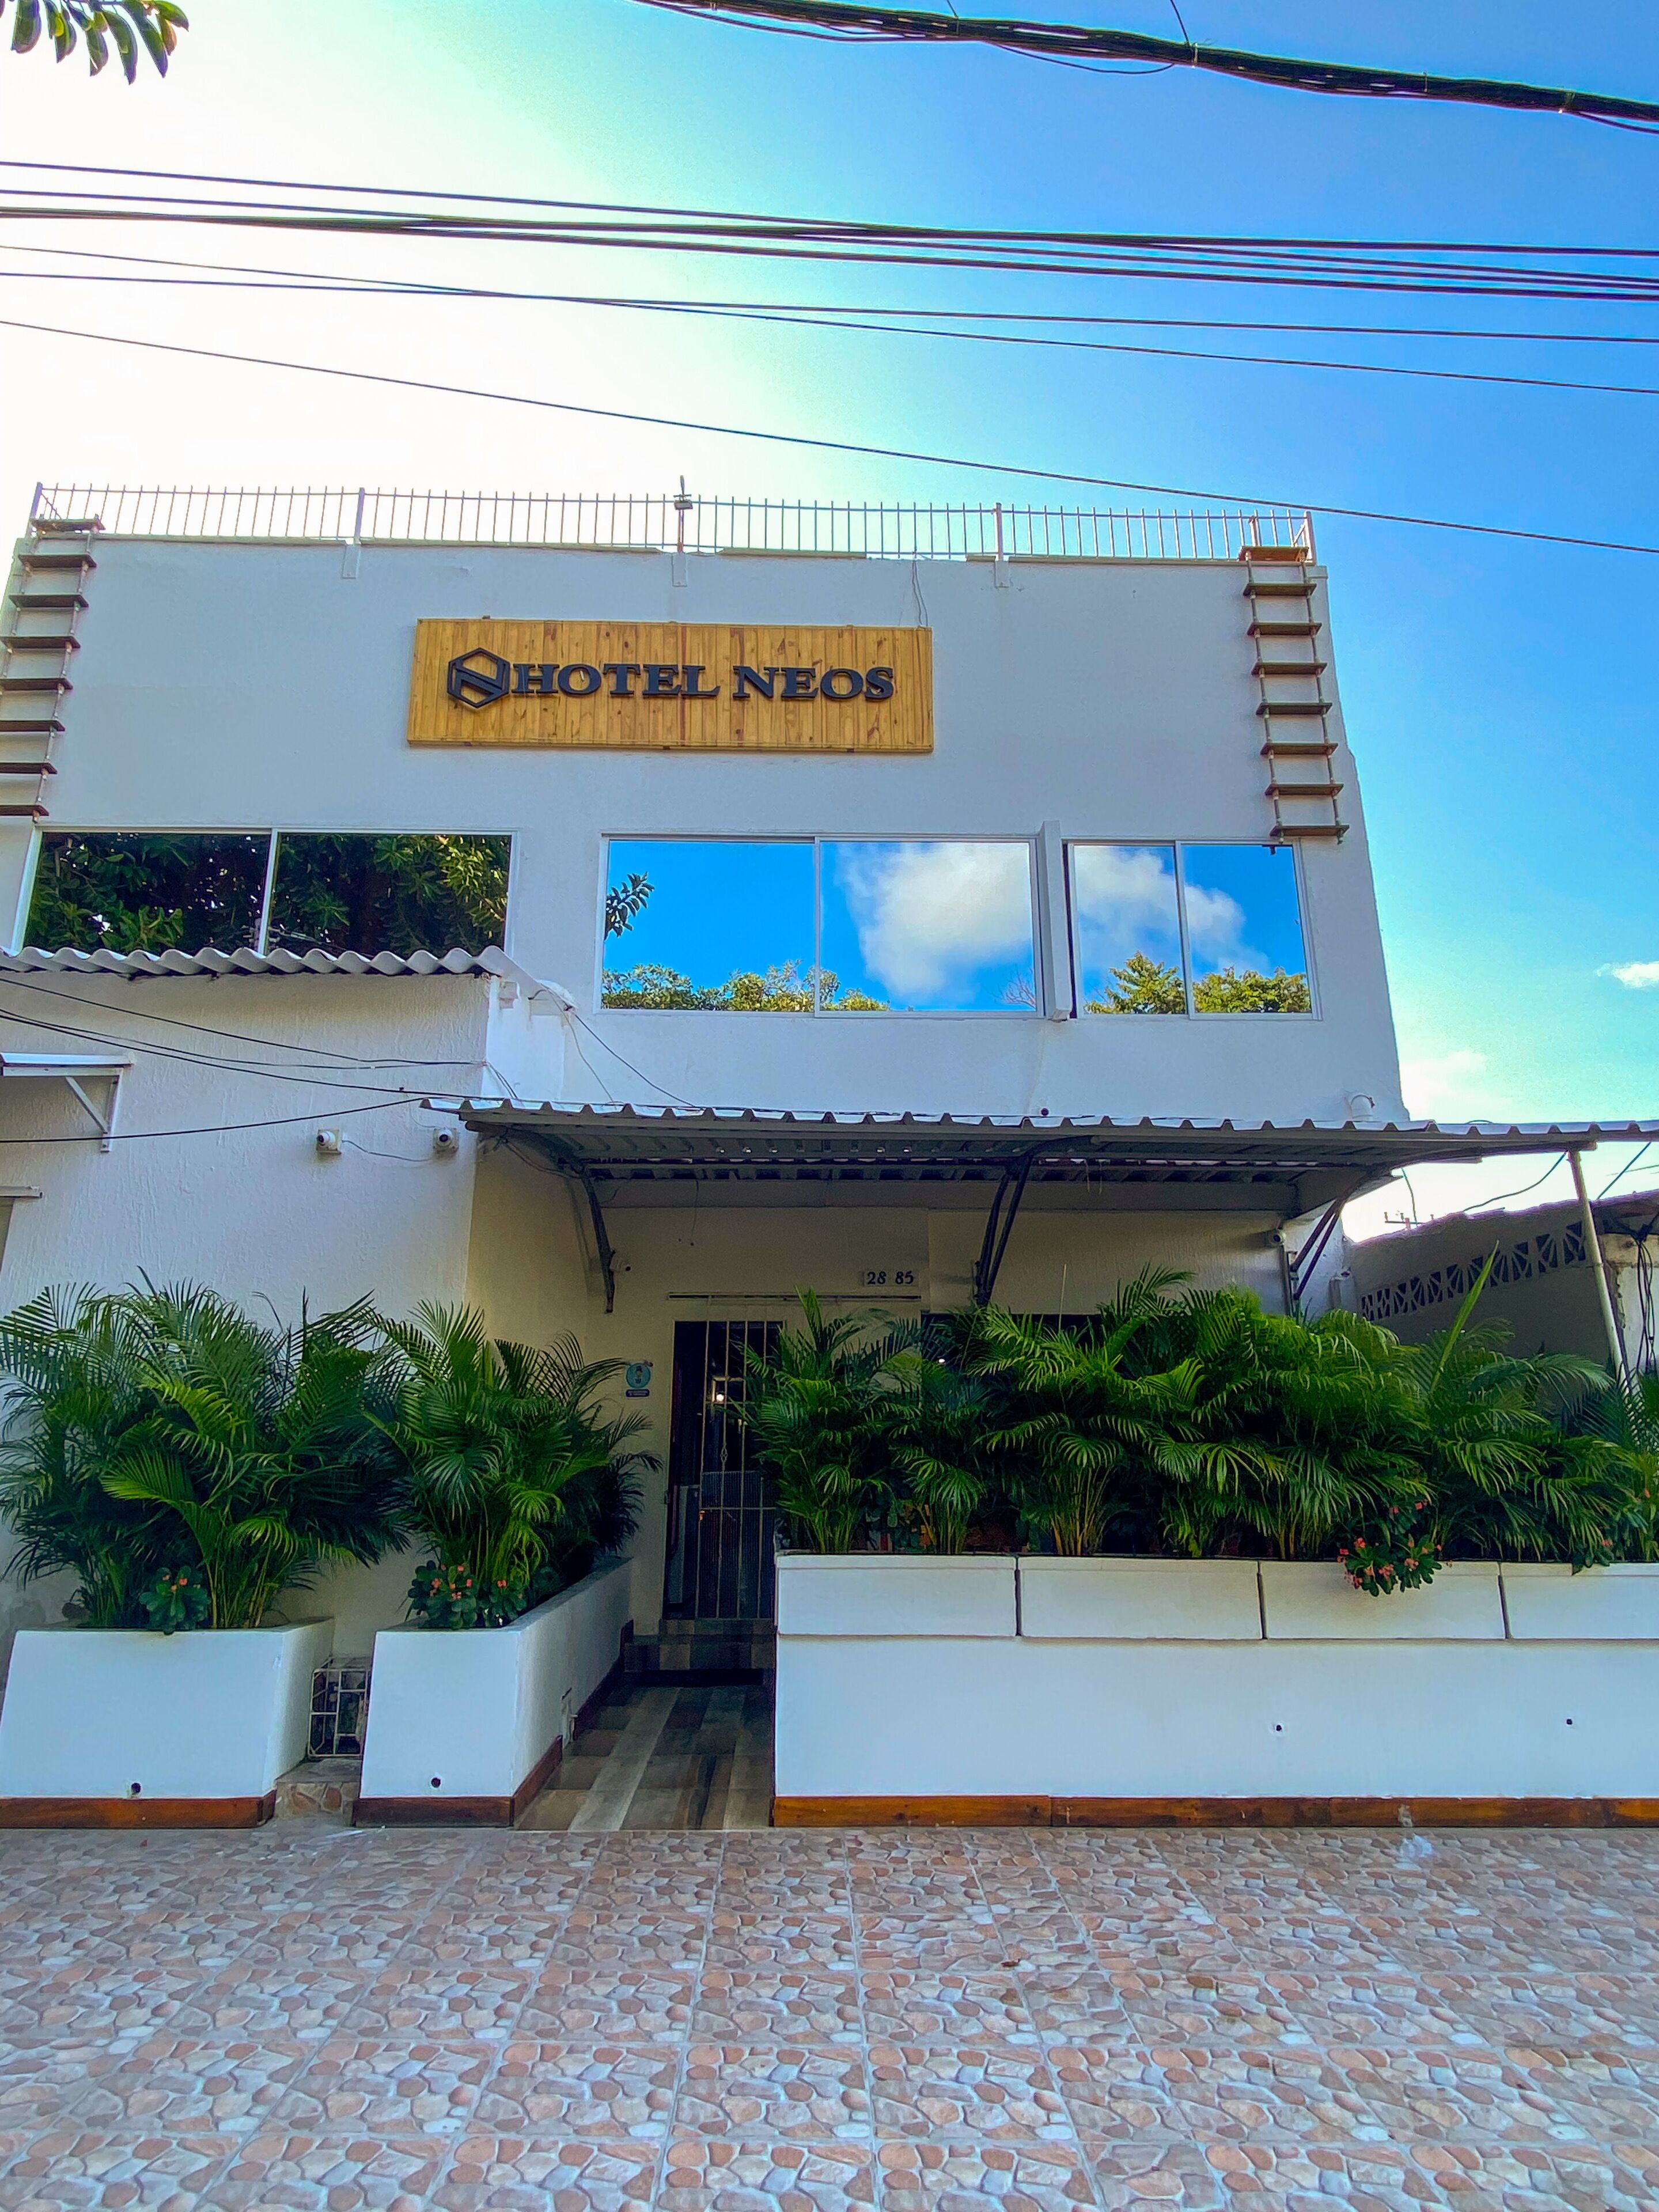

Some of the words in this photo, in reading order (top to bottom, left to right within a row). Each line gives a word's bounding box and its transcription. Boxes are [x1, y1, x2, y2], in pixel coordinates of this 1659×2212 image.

[511, 663, 720, 697] HOTEL
[732, 665, 894, 700] NEOS
[867, 1271, 887, 1285] 28
[895, 1270, 914, 1285] 85
